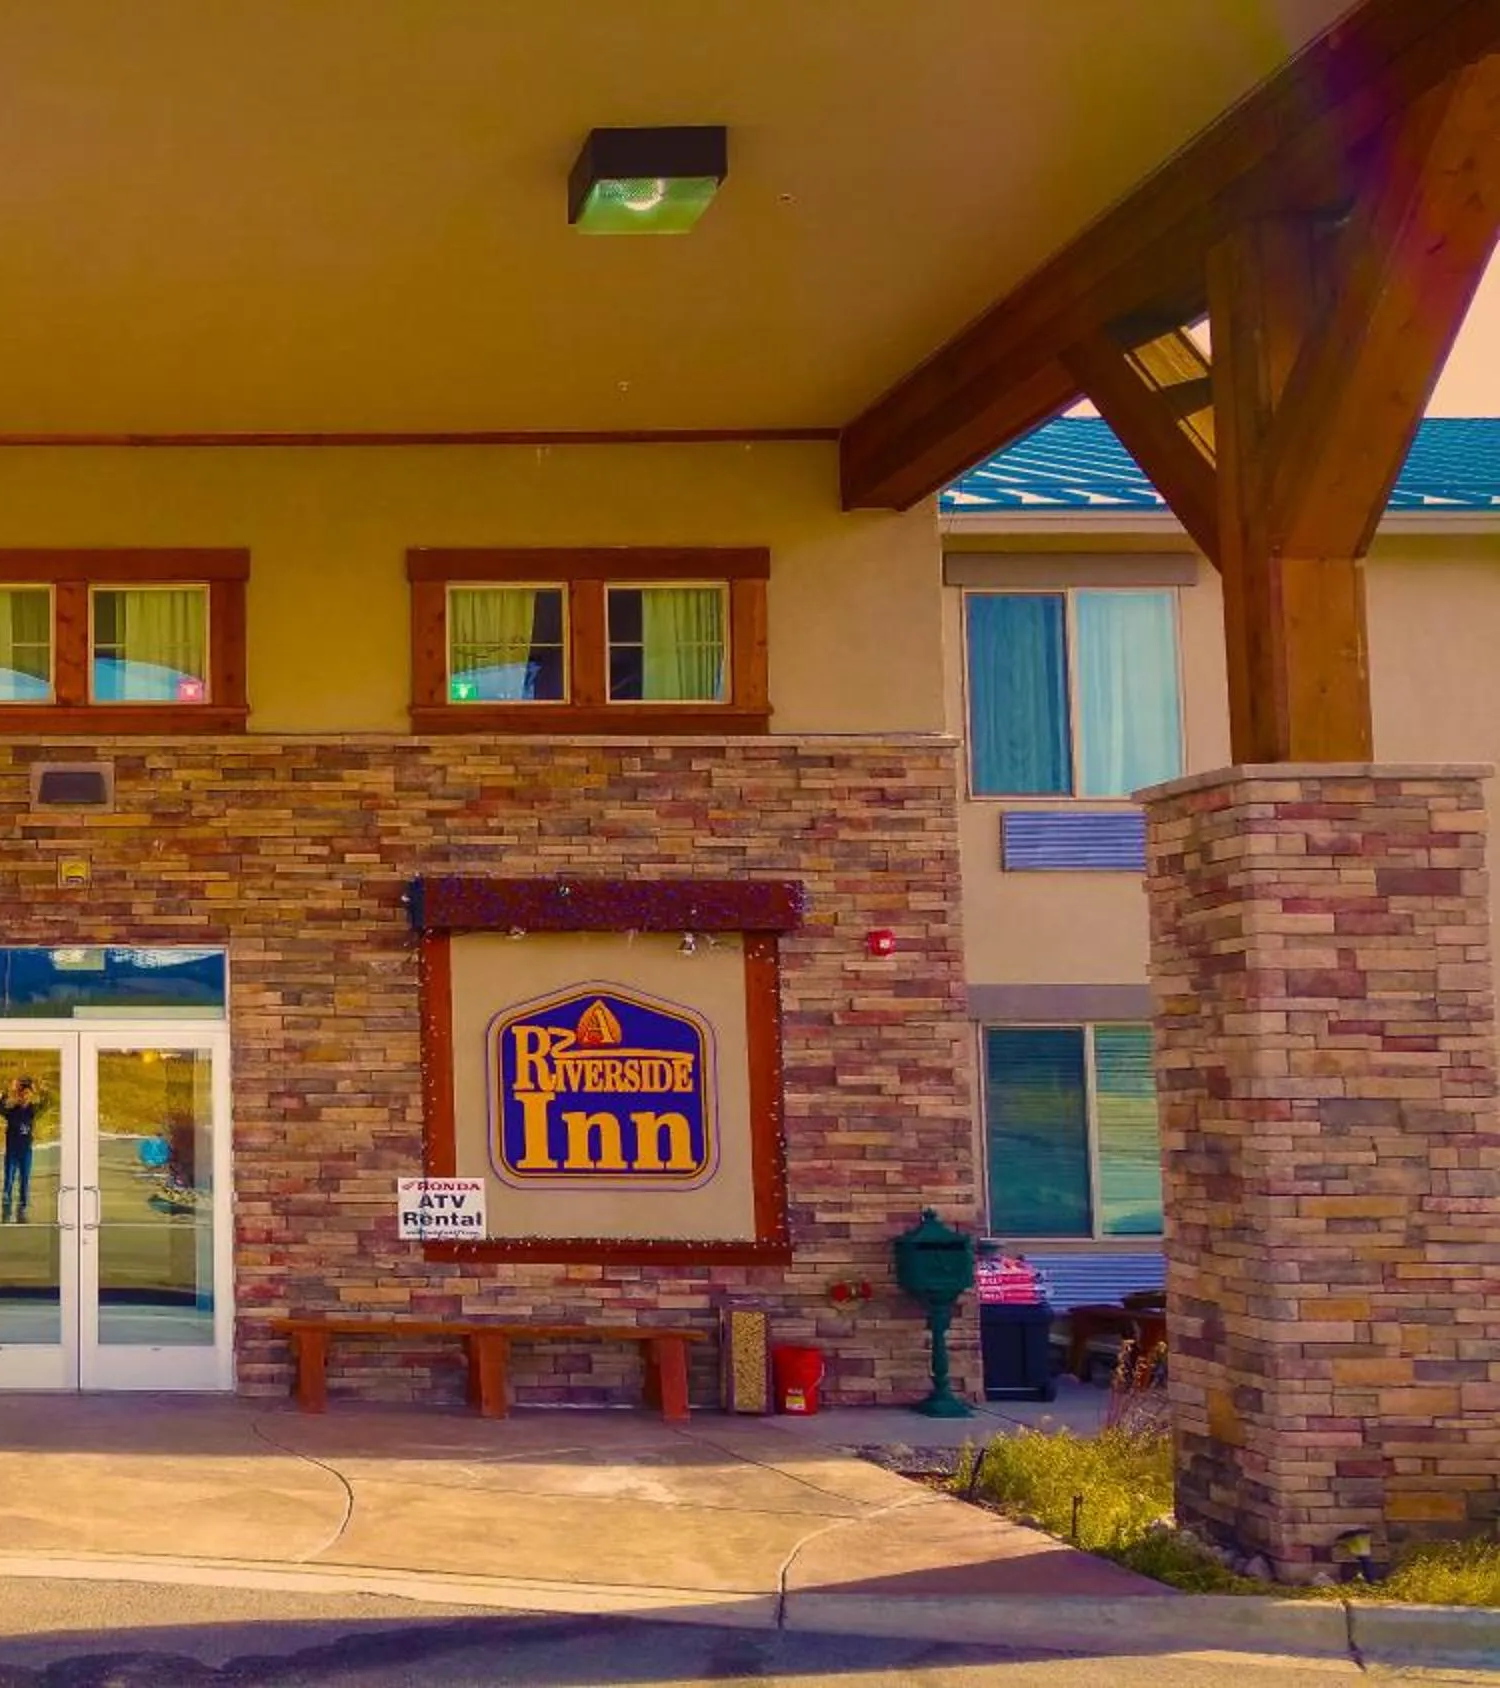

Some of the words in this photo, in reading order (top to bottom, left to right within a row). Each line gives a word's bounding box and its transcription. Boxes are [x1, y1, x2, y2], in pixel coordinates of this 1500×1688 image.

[511, 1025, 694, 1093] RIVERSIDE
[514, 1091, 697, 1169] Inn
[403, 1211, 482, 1227] Rental
[419, 1194, 466, 1209] ATV
